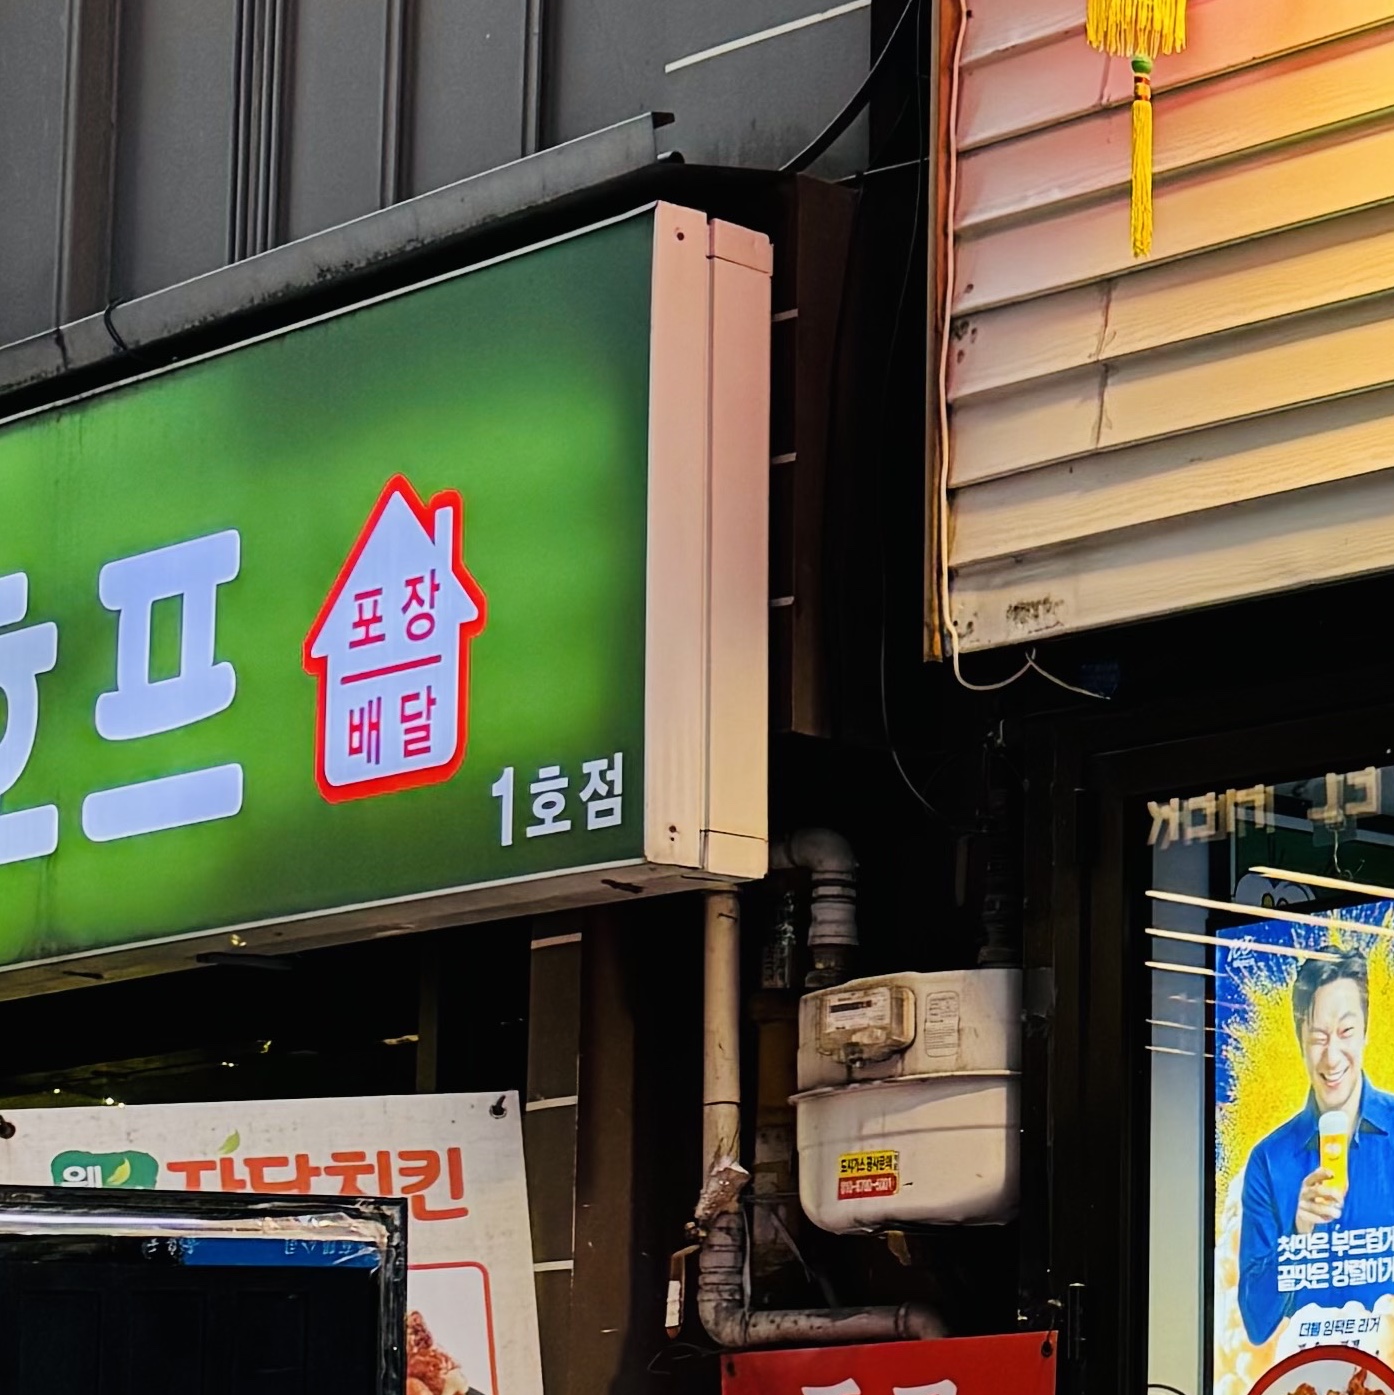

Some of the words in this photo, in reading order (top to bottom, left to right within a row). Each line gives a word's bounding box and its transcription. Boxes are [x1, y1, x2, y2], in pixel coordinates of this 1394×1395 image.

[348, 570, 441, 651] 포장
[348, 686, 437, 765] 배달
[491, 751, 624, 848] 1호점
[1277, 1231, 1329, 1262] 첫맛은
